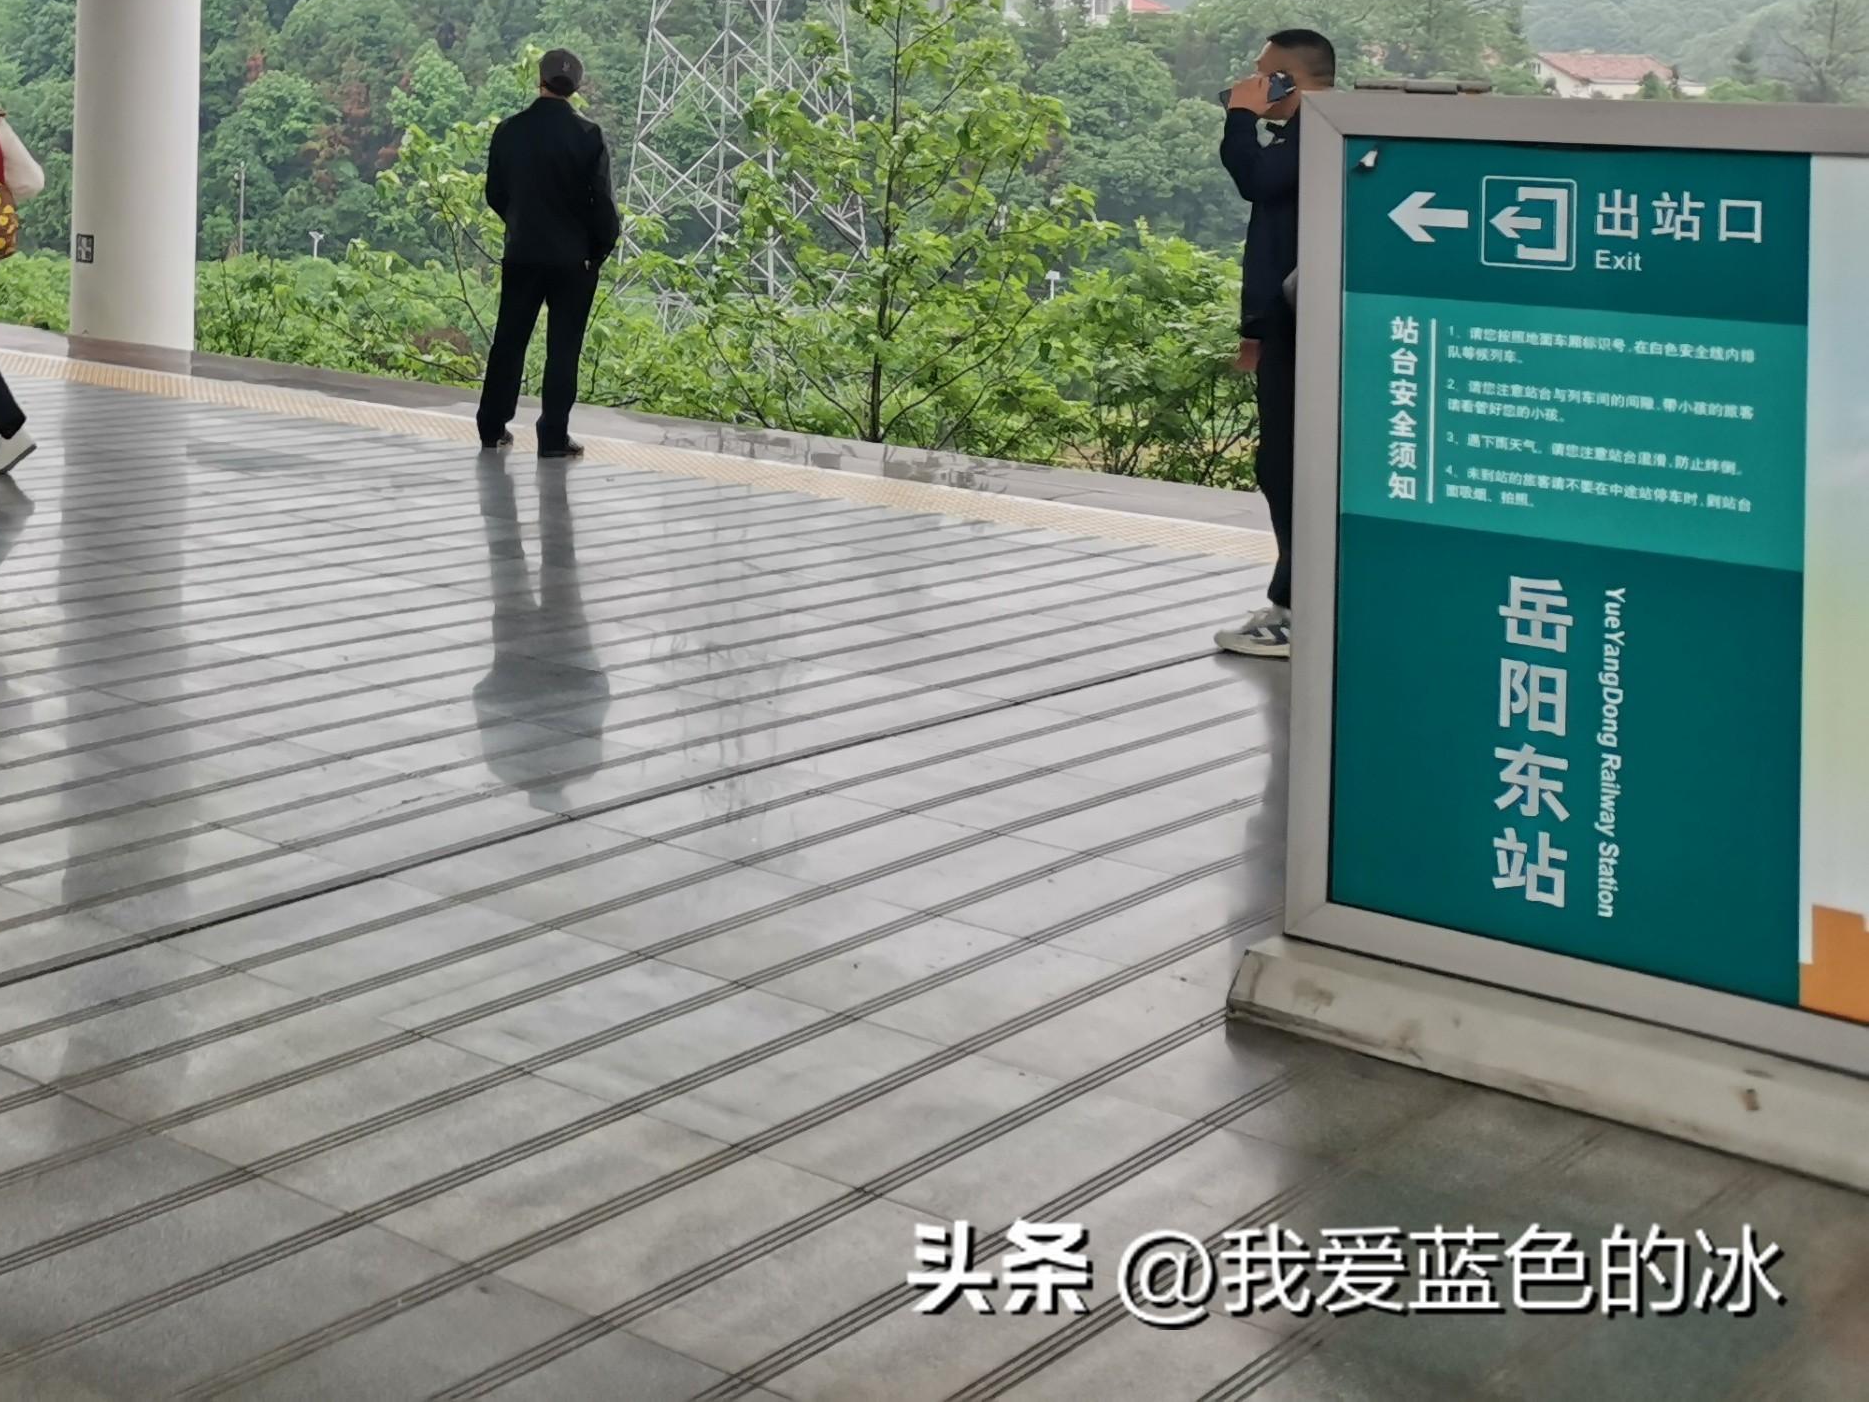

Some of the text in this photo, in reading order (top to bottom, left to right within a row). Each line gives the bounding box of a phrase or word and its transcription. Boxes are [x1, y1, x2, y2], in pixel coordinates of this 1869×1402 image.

[1594, 188, 1764, 244] 出站口
[1594, 249, 1643, 272] Exit
[1387, 315, 1420, 502] 站台安全须知
[1492, 575, 1574, 908] 岳阳东站
[1594, 587, 1626, 919] YueYangDong Railway Station
